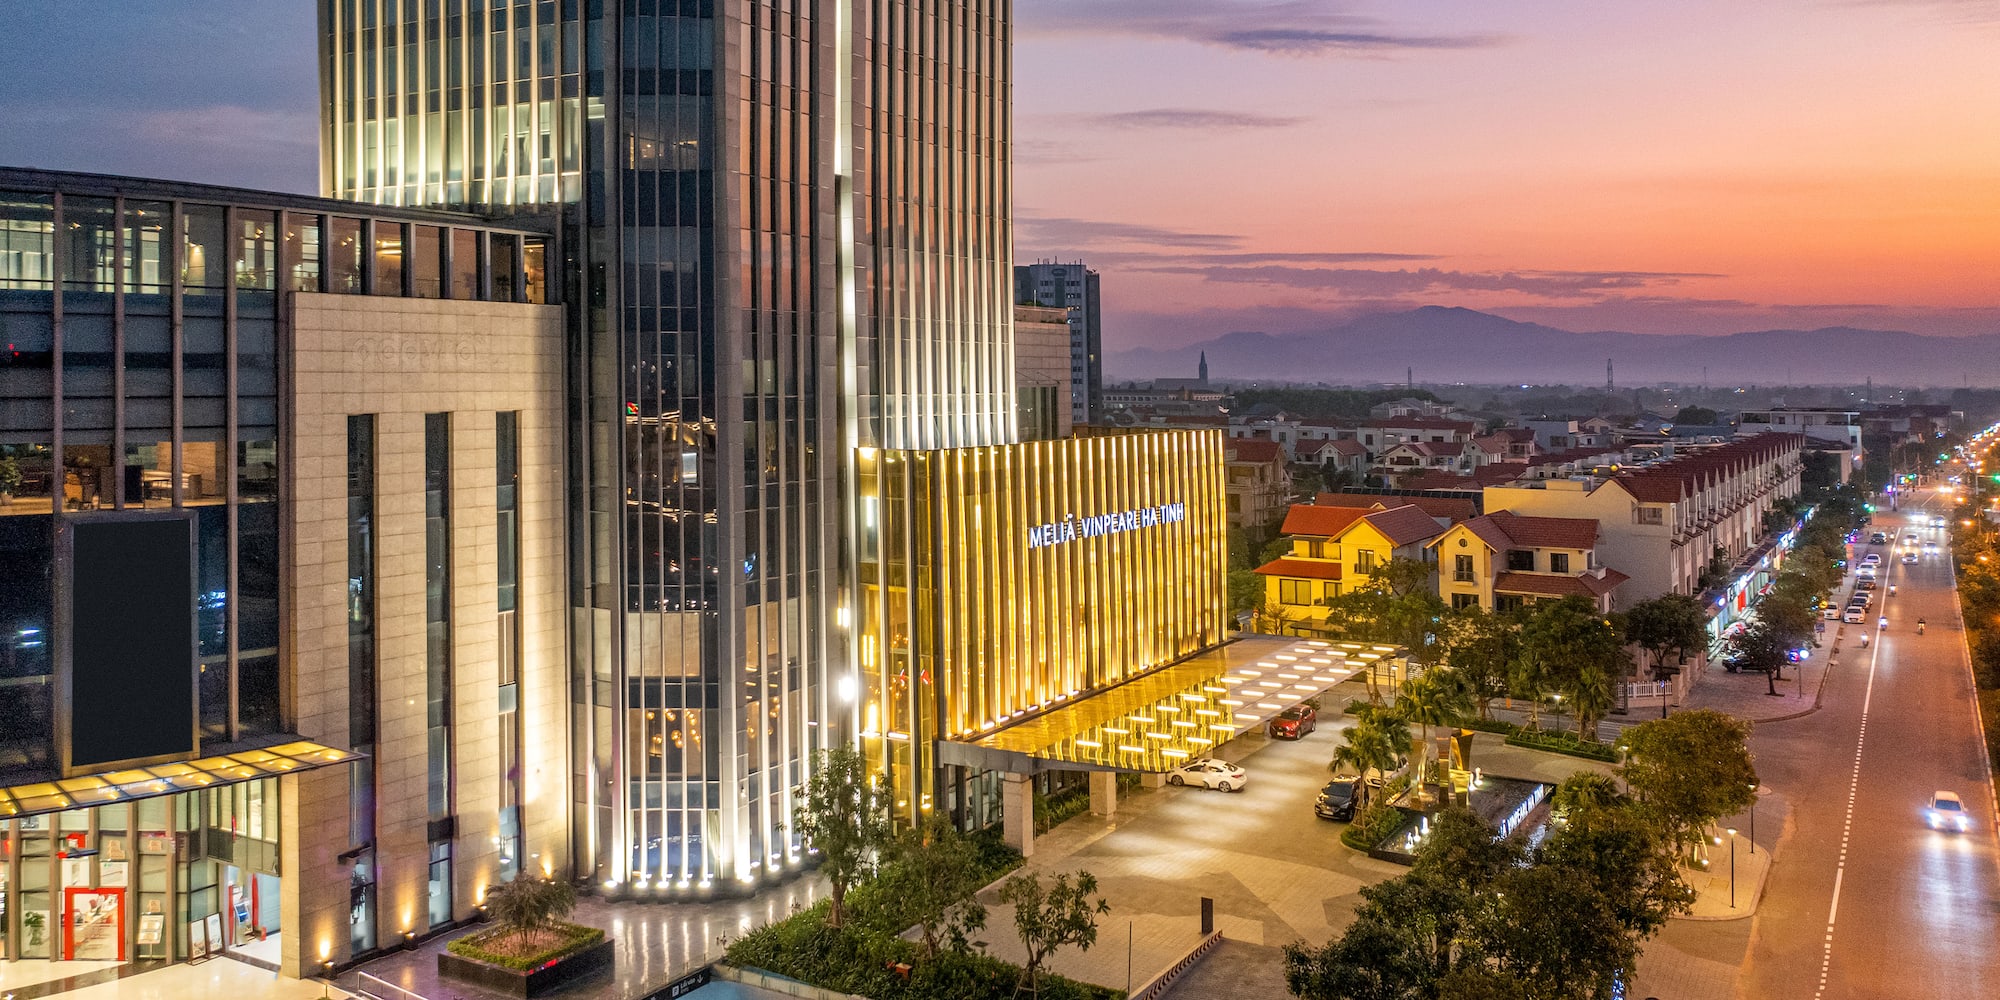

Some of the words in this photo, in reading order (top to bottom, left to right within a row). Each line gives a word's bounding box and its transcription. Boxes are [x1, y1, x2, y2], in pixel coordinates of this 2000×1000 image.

[1081, 510, 1139, 538] VINPEARL
[1142, 507, 1158, 528] HA
[1160, 502, 1184, 524] TINH
